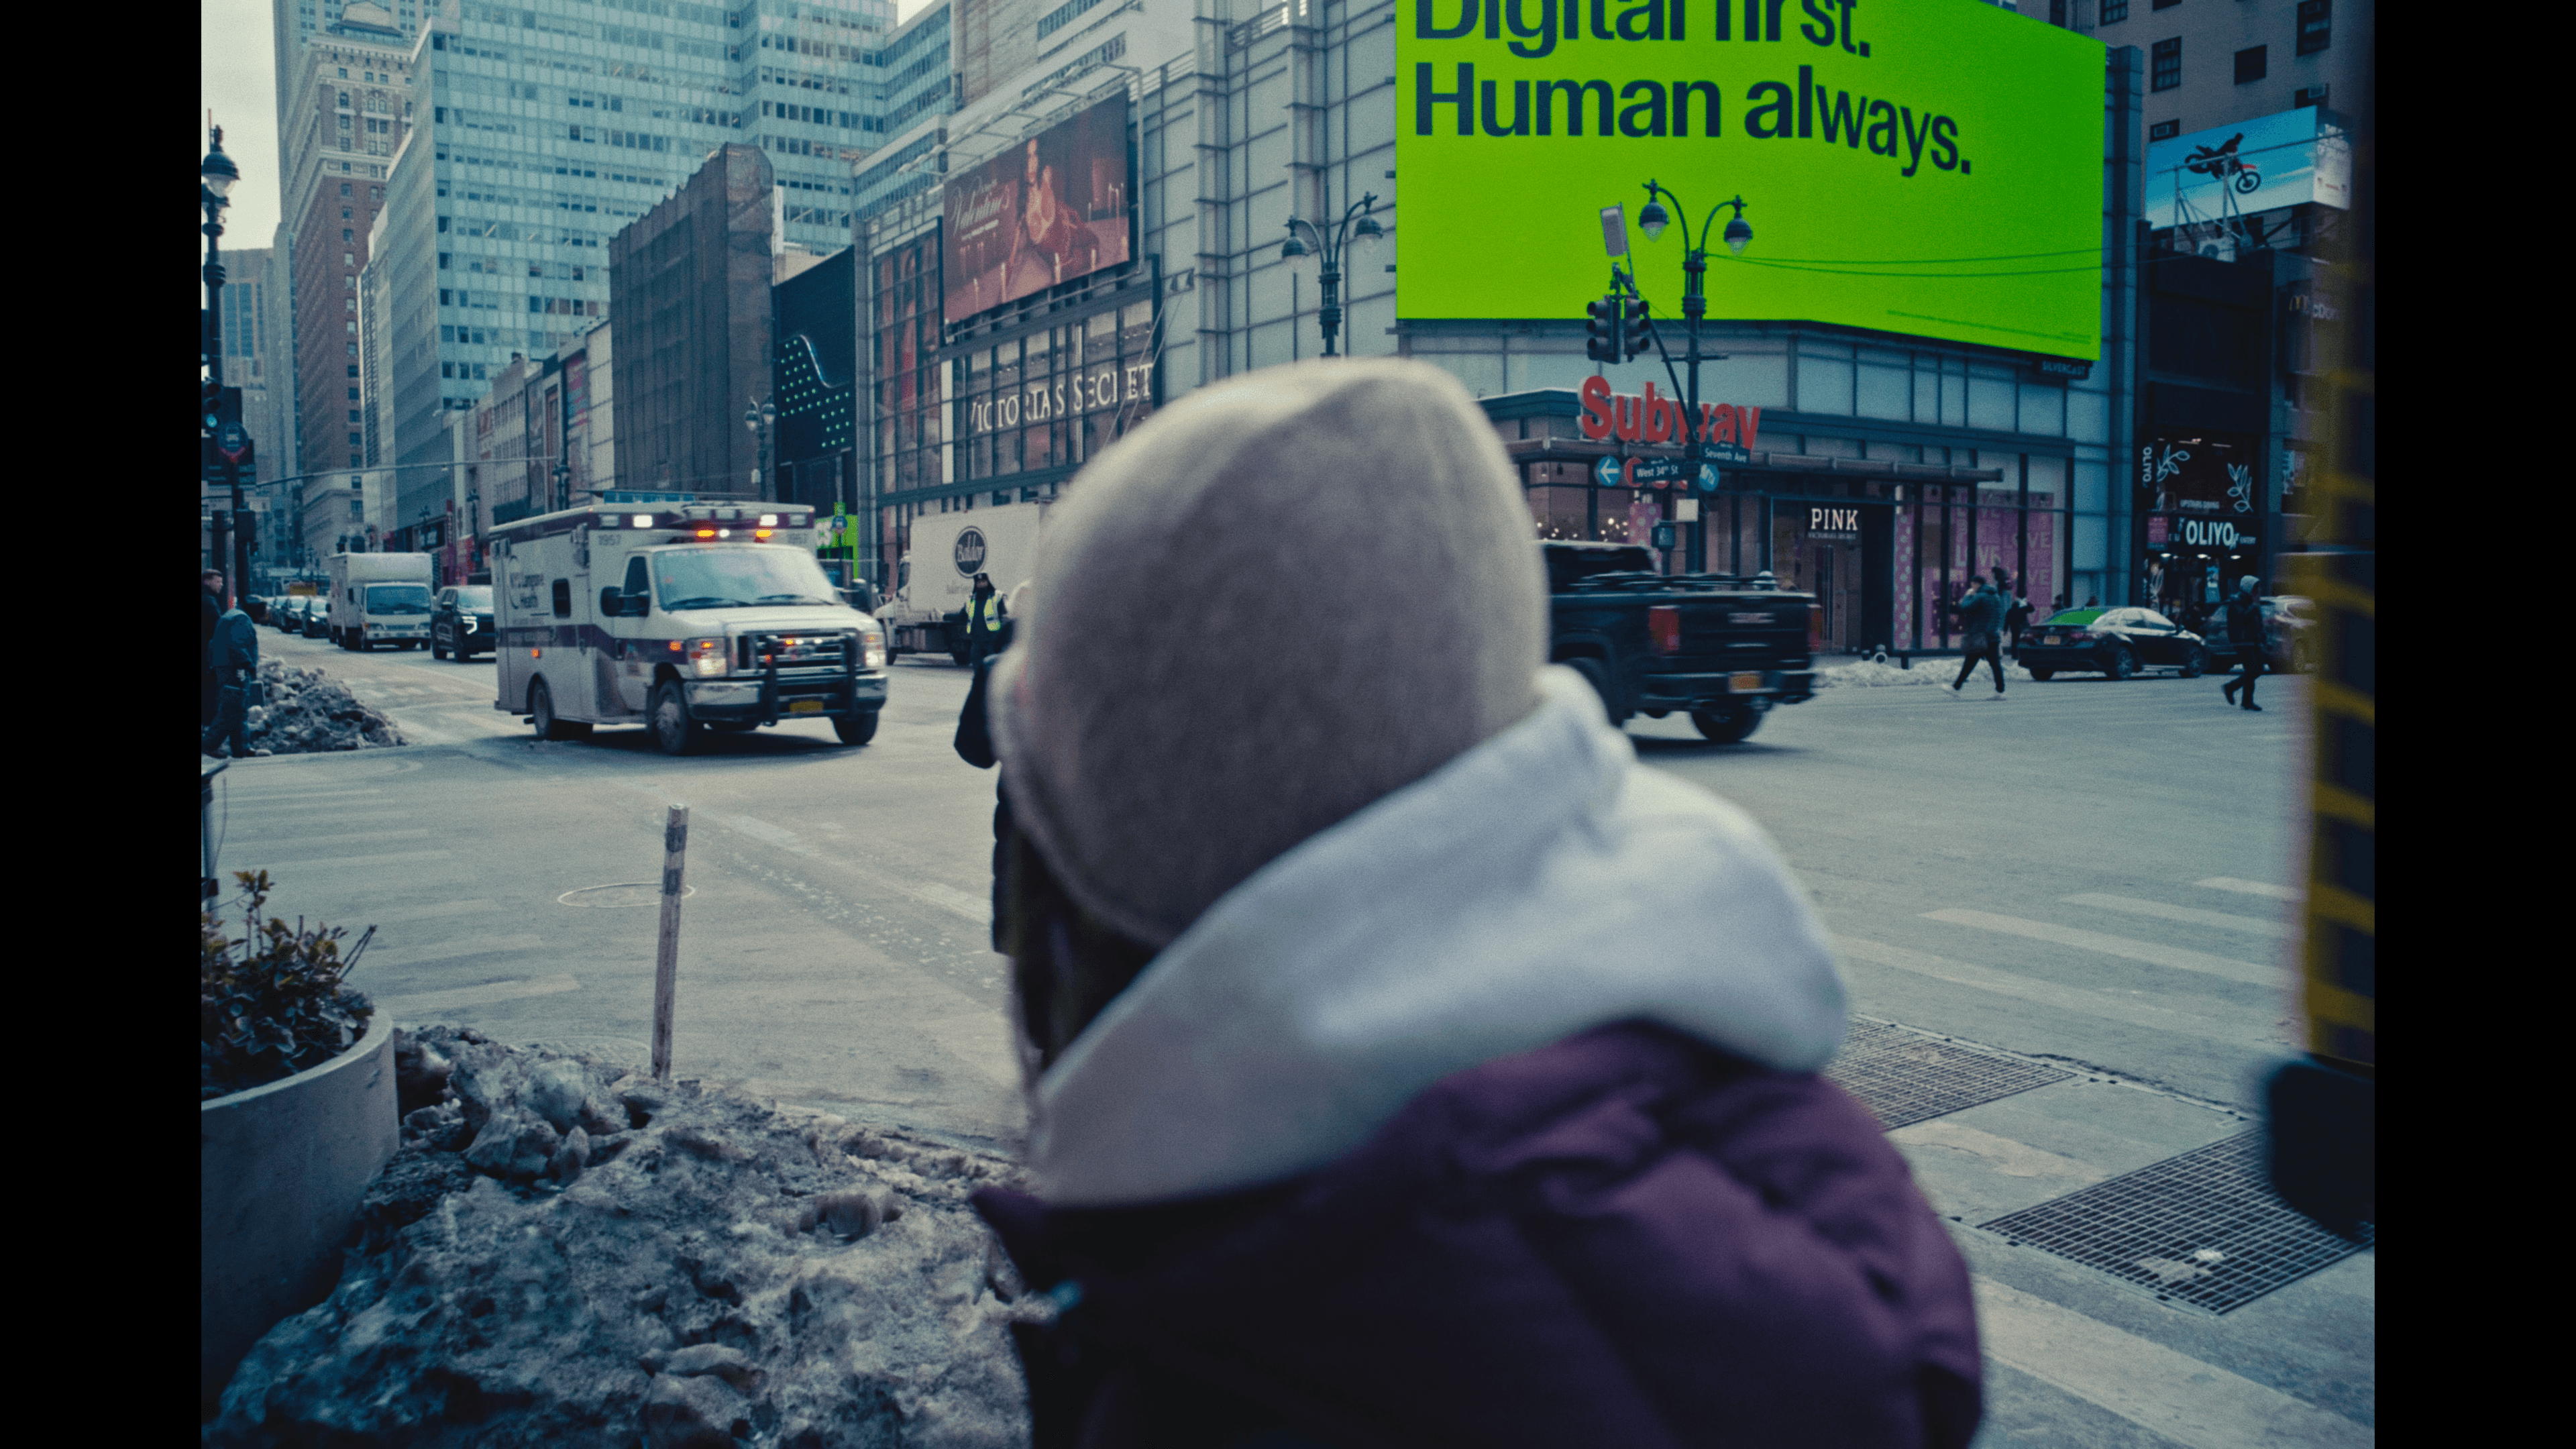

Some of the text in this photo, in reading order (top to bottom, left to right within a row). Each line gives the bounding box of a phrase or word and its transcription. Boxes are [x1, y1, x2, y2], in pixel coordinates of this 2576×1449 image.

[1416, 0, 1685, 58] Digital
[1416, 62, 1971, 178] Human always.
[971, 384, 1065, 433] ICTOIAS
[1581, 375, 1761, 455] Subway
[1705, 447, 1747, 462] Seventh Ave
[2142, 446, 2153, 482] OLIYO
[1636, 468, 1654, 478] West
[1671, 465, 1678, 475] St
[1811, 508, 1858, 531] PINK
[2186, 520, 2235, 547] OLIYO
[1955, 544, 2000, 568] LVE
